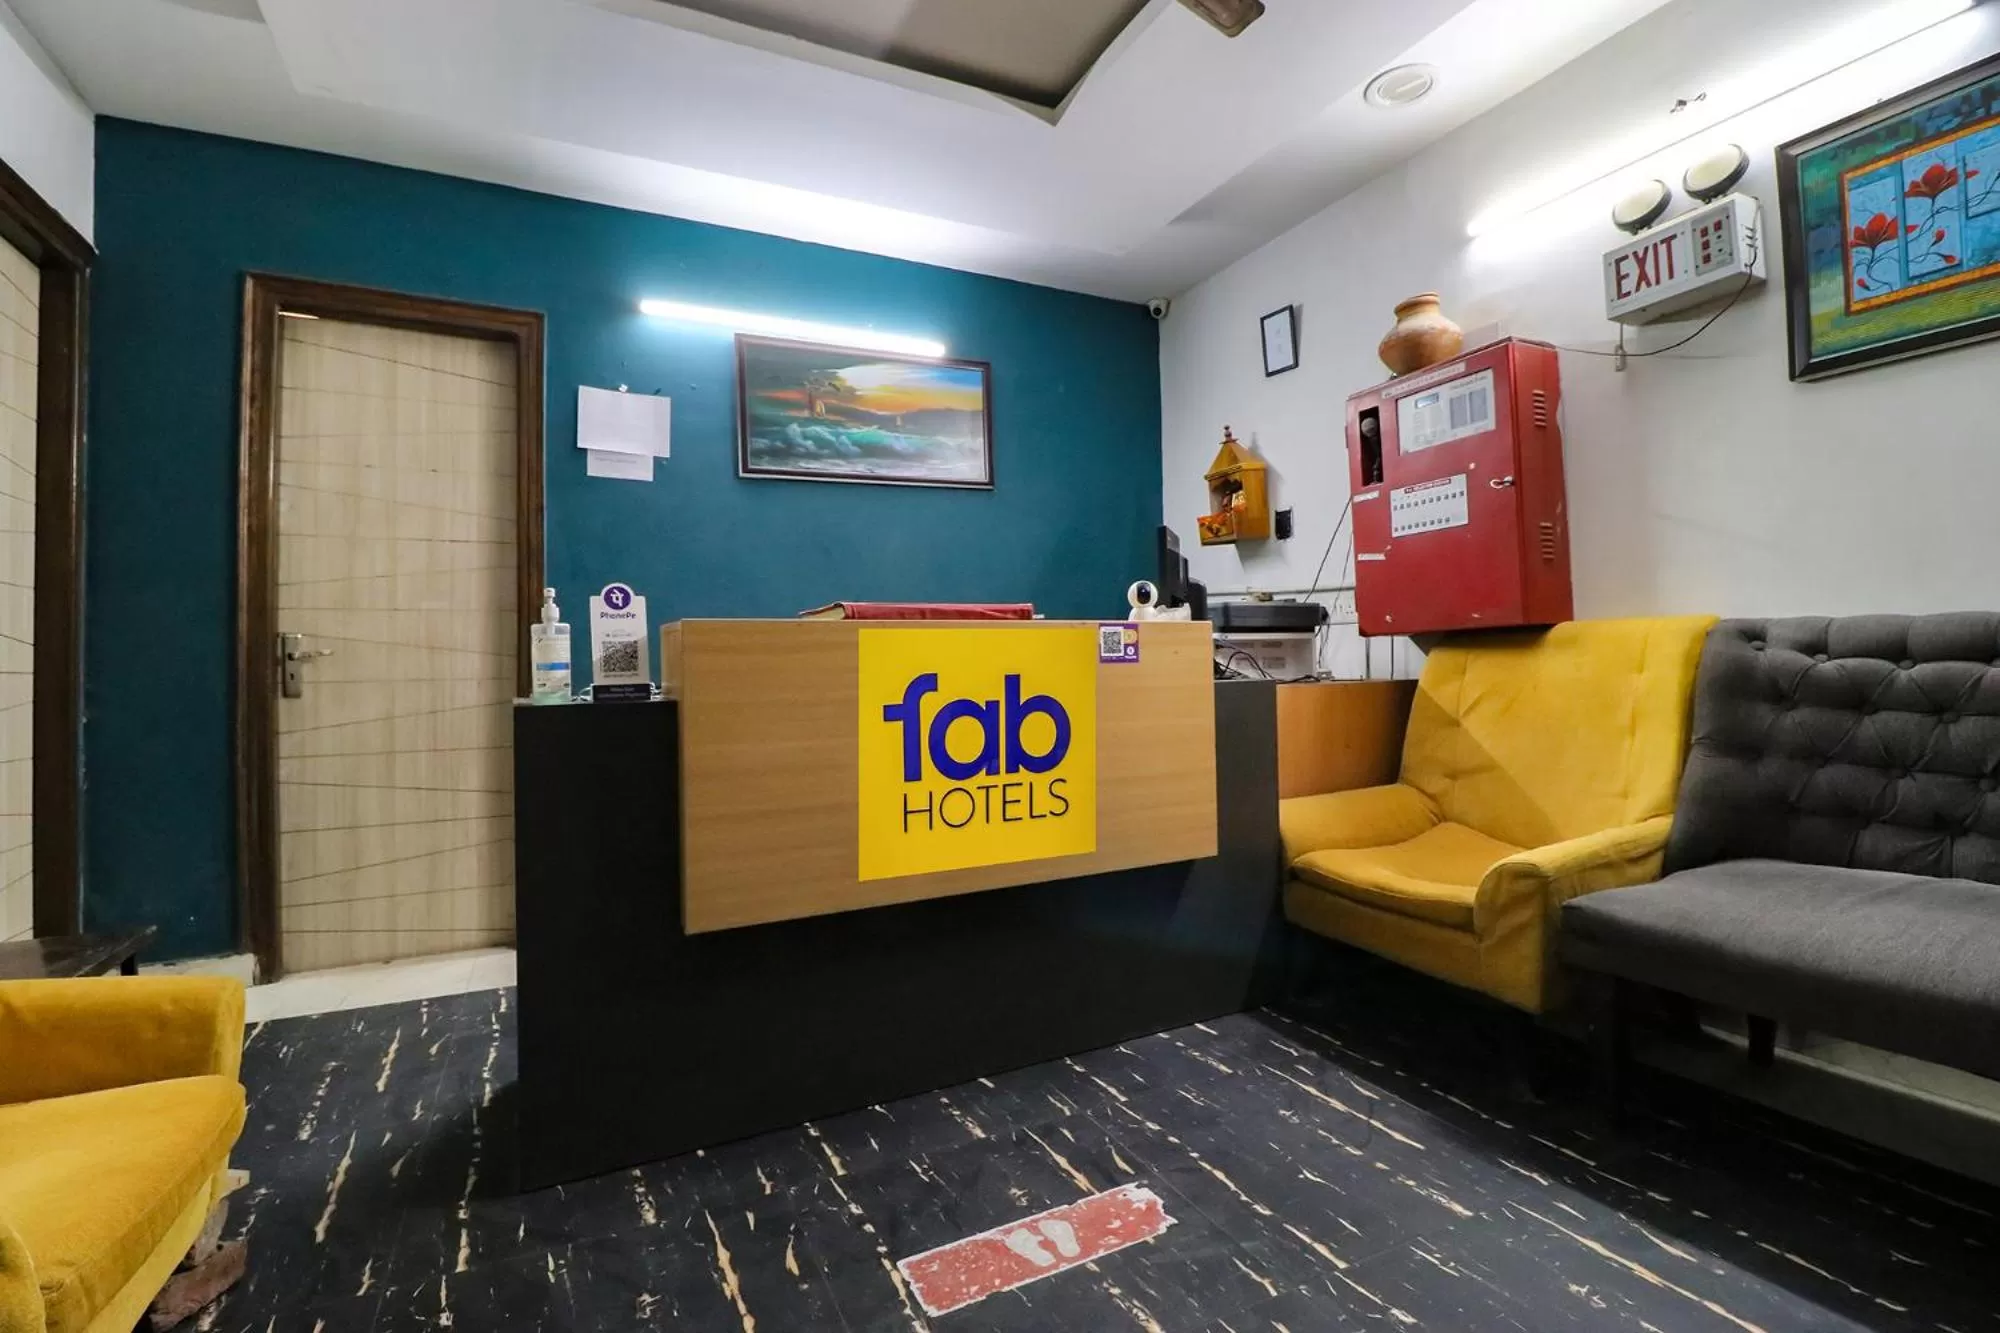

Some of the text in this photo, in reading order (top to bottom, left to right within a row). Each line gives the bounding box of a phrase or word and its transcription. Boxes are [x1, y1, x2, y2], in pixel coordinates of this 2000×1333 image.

[1614, 233, 1677, 300] EXIT
[883, 672, 1071, 782] fab
[903, 778, 1070, 833] HOTELS
